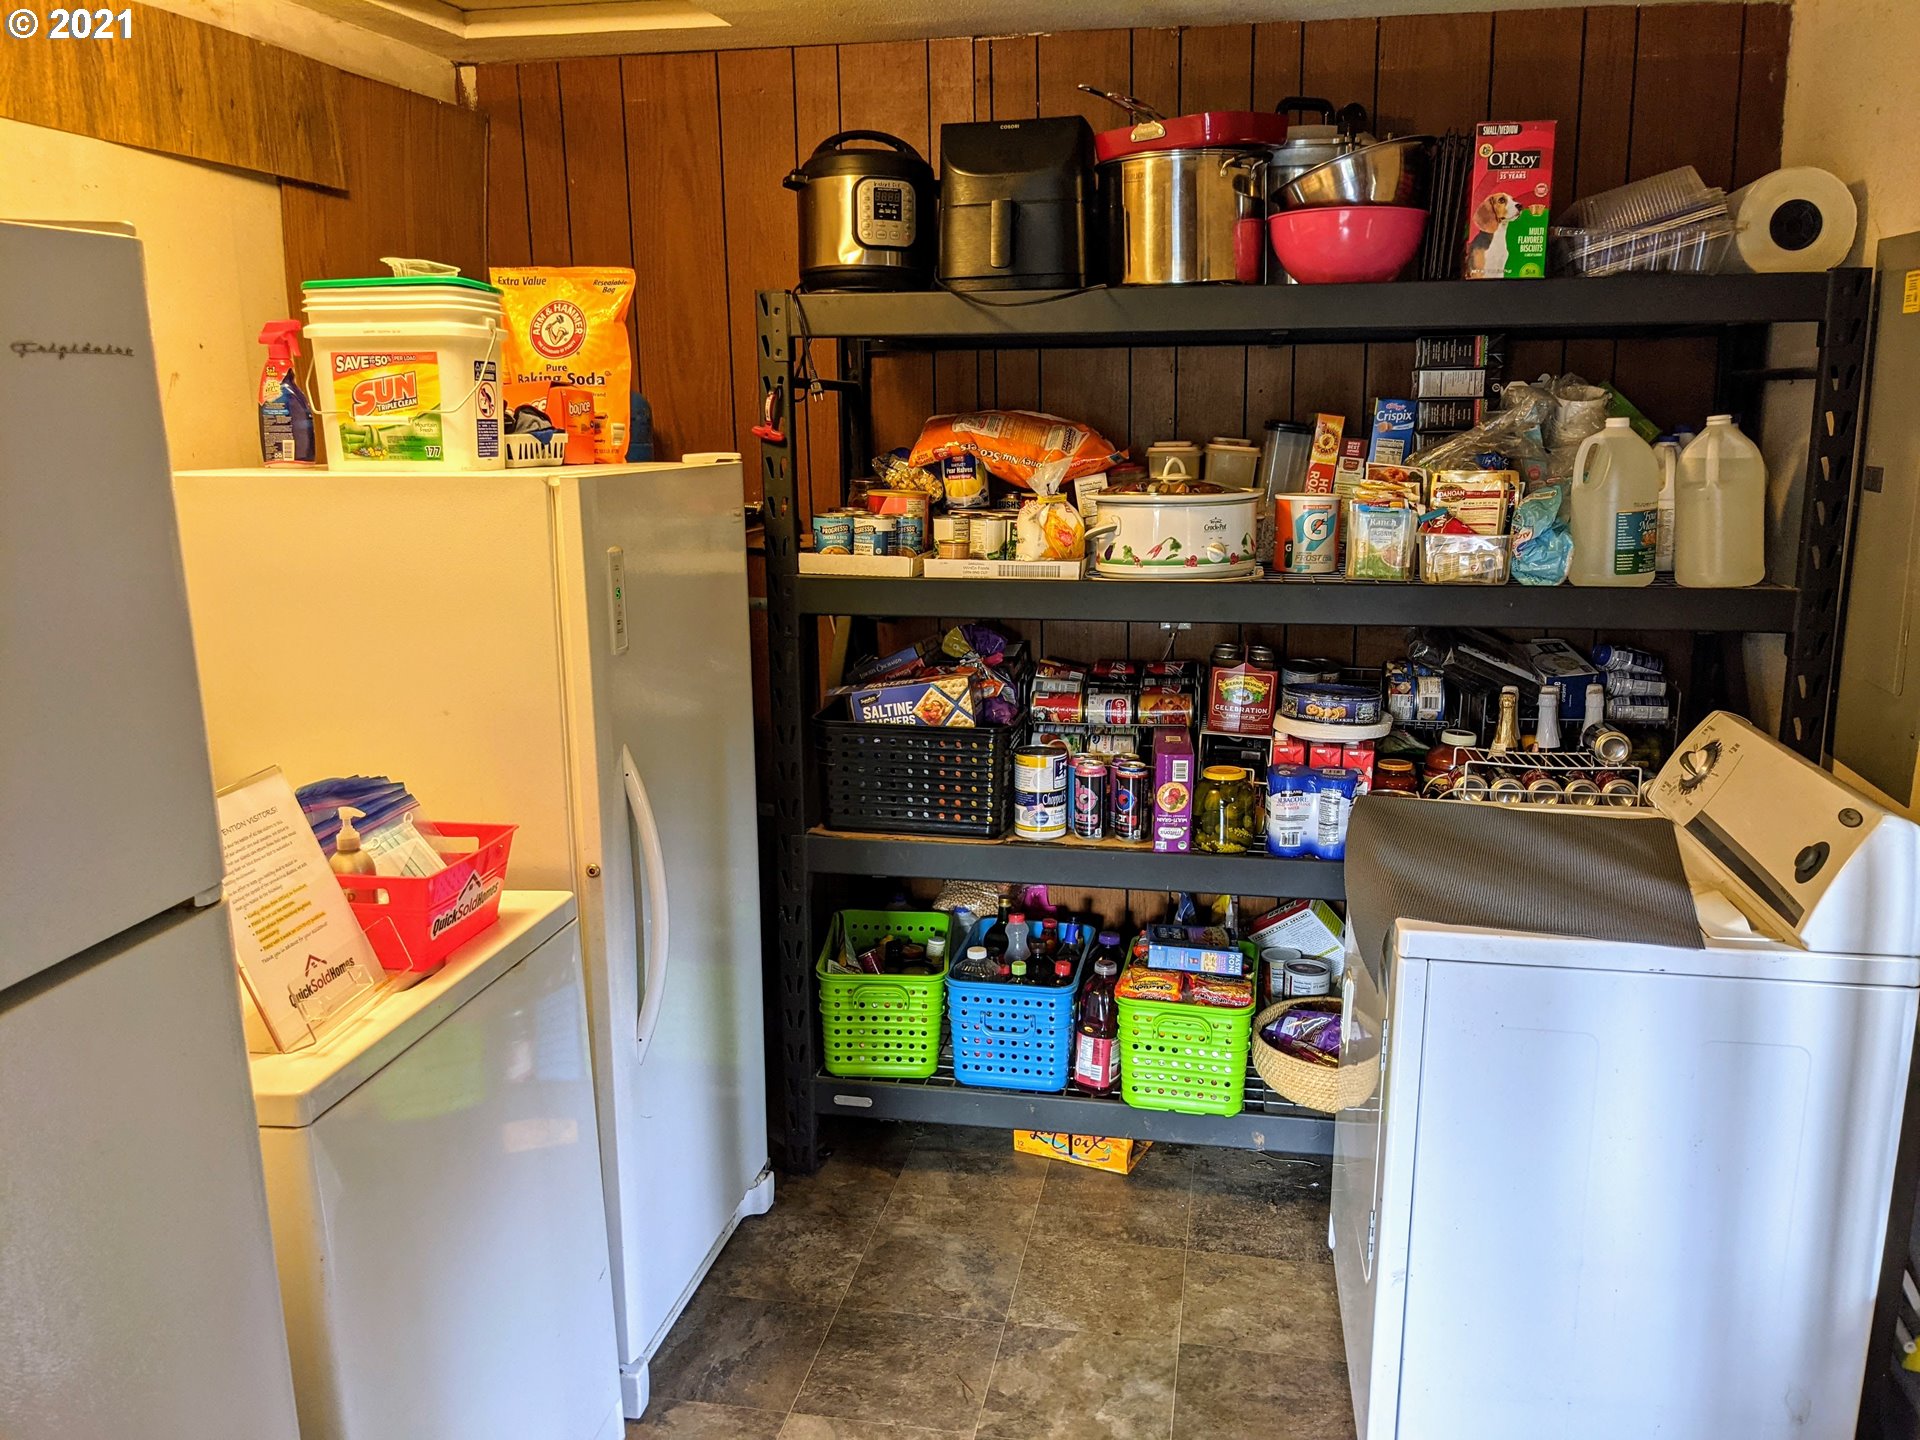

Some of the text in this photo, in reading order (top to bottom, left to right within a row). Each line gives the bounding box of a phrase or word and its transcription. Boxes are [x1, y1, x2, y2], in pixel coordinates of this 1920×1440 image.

[1483, 125, 1519, 136] SMALL/MEDIUM
[1510, 153, 1538, 169] Roy
[1529, 227, 1544, 236] MULTI
[1518, 236, 1544, 245] FLAVORED
[1520, 244, 1543, 253] BISCUITS
[498, 276, 547, 286] Extra Value
[593, 279, 628, 287] Resealable
[602, 286, 616, 294] Bag
[532, 314, 547, 335] ARM
[554, 303, 583, 335] HAMMER
[10, 341, 135, 360] Frigidaire
[335, 355, 370, 374] SAVE
[375, 355, 392, 367] 50%
[546, 363, 568, 373] Pure
[567, 372, 606, 386] Soda
[353, 370, 418, 417] SUN
[376, 398, 418, 412] TRIPLE CLEAN
[568, 400, 591, 416] bounce
[1376, 409, 1412, 423] Crispix
[424, 446, 441, 458] 177
[1025, 457, 1044, 469] oney
[946, 466, 973, 475] Pear Halves
[1436, 490, 1466, 499] IDAHOAN
[1203, 523, 1227, 531] Crock-Pot
[1370, 517, 1397, 526] Ranch
[1638, 520, 1657, 532] Mon
[821, 525, 850, 535] PROGRESSO
[854, 525, 874, 534] OGRESSO
[1285, 544, 1292, 552] G
[1295, 554, 1322, 562] FROST
[862, 701, 914, 720] SALTINE
[1214, 704, 1268, 714] CELEBRATION
[221, 806, 279, 836] ENTION VISITORS!
[432, 881, 499, 937] QuickSoldHomes
[288, 957, 355, 1009] QuickSoldHomes
[1017, 1139, 1024, 1147] 12
[1052, 1132, 1108, 1154] Coix
